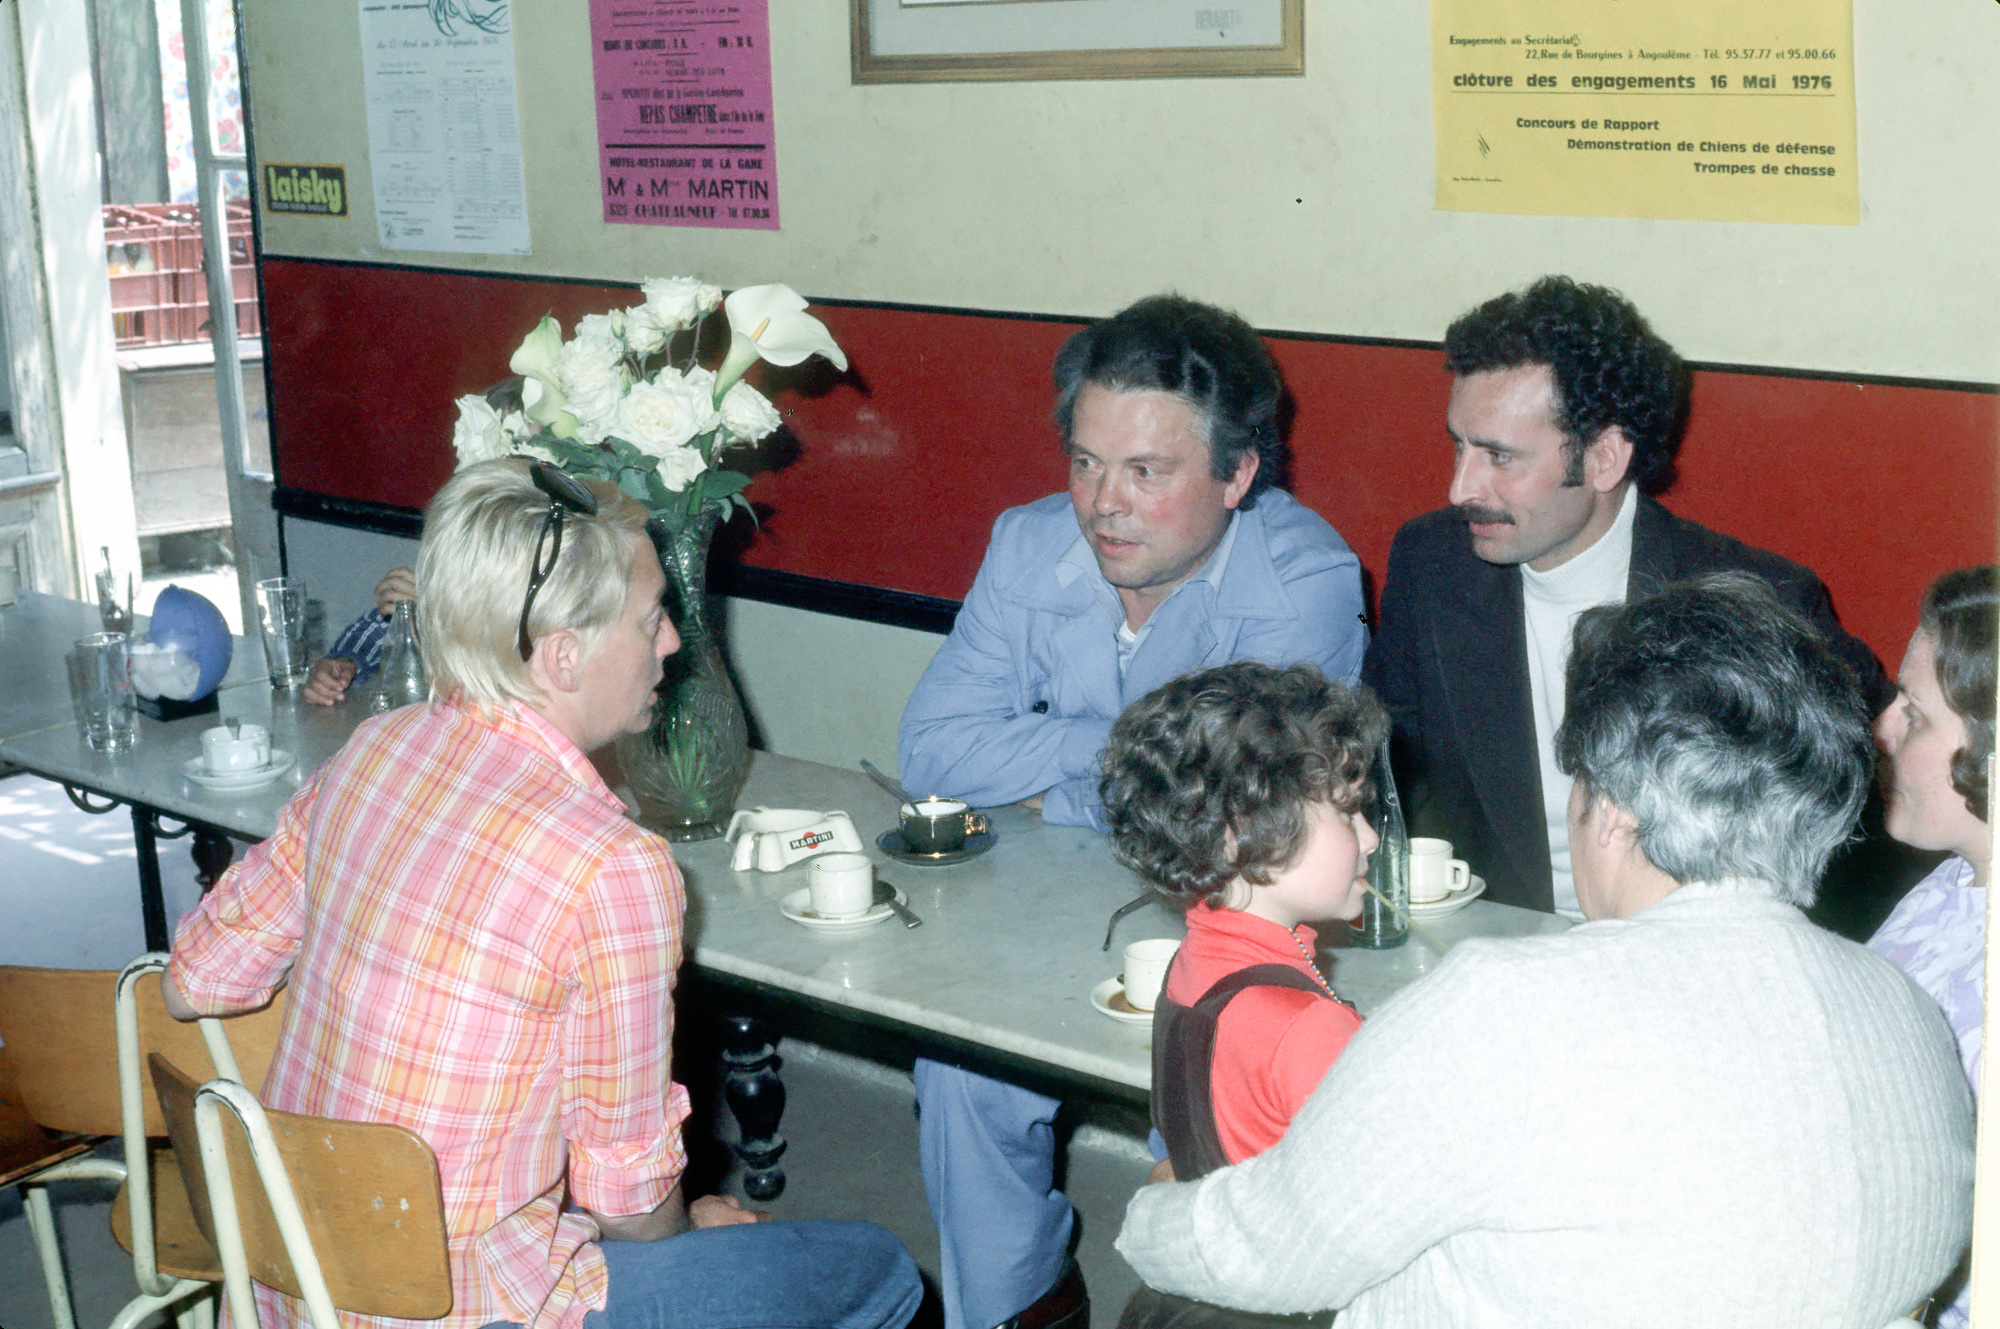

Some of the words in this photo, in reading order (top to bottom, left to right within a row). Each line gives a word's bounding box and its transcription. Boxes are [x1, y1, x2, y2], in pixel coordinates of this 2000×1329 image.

[1449, 35, 1507, 47] Engagements
[1511, 38, 1522, 46] au
[1562, 49, 1573, 59] de
[1576, 49, 1623, 61] Bourgines
[1638, 49, 1691, 61] Angoulême
[1776, 49, 1785, 59] et
[1787, 48, 1836, 59] 95.00.66
[1453, 73, 1513, 87] clôture
[1526, 73, 1558, 87] des
[1571, 75, 1696, 90] engagements
[1710, 74, 1728, 88] 16
[1742, 74, 1777, 89] Mai
[1792, 75, 1832, 89] 1976
[1516, 118, 1576, 129] Concours
[1581, 118, 1598, 130] de
[1603, 119, 1660, 132] Rapport
[1567, 139, 1671, 152] Démonstration
[1677, 141, 1694, 152] de
[1699, 141, 1747, 153] Chiens
[1752, 142, 1770, 154] de
[1775, 142, 1836, 155] défense
[702, 158, 713, 169] DE
[720, 158, 731, 169] LA
[738, 159, 763, 169] GARE
[1694, 162, 1756, 176] Trompes
[1761, 163, 1779, 175] de
[1784, 164, 1836, 177] chasse
[636, 183, 644, 197] &
[688, 179, 769, 200] MARTIN
[791, 831, 832, 849] MARTINI
